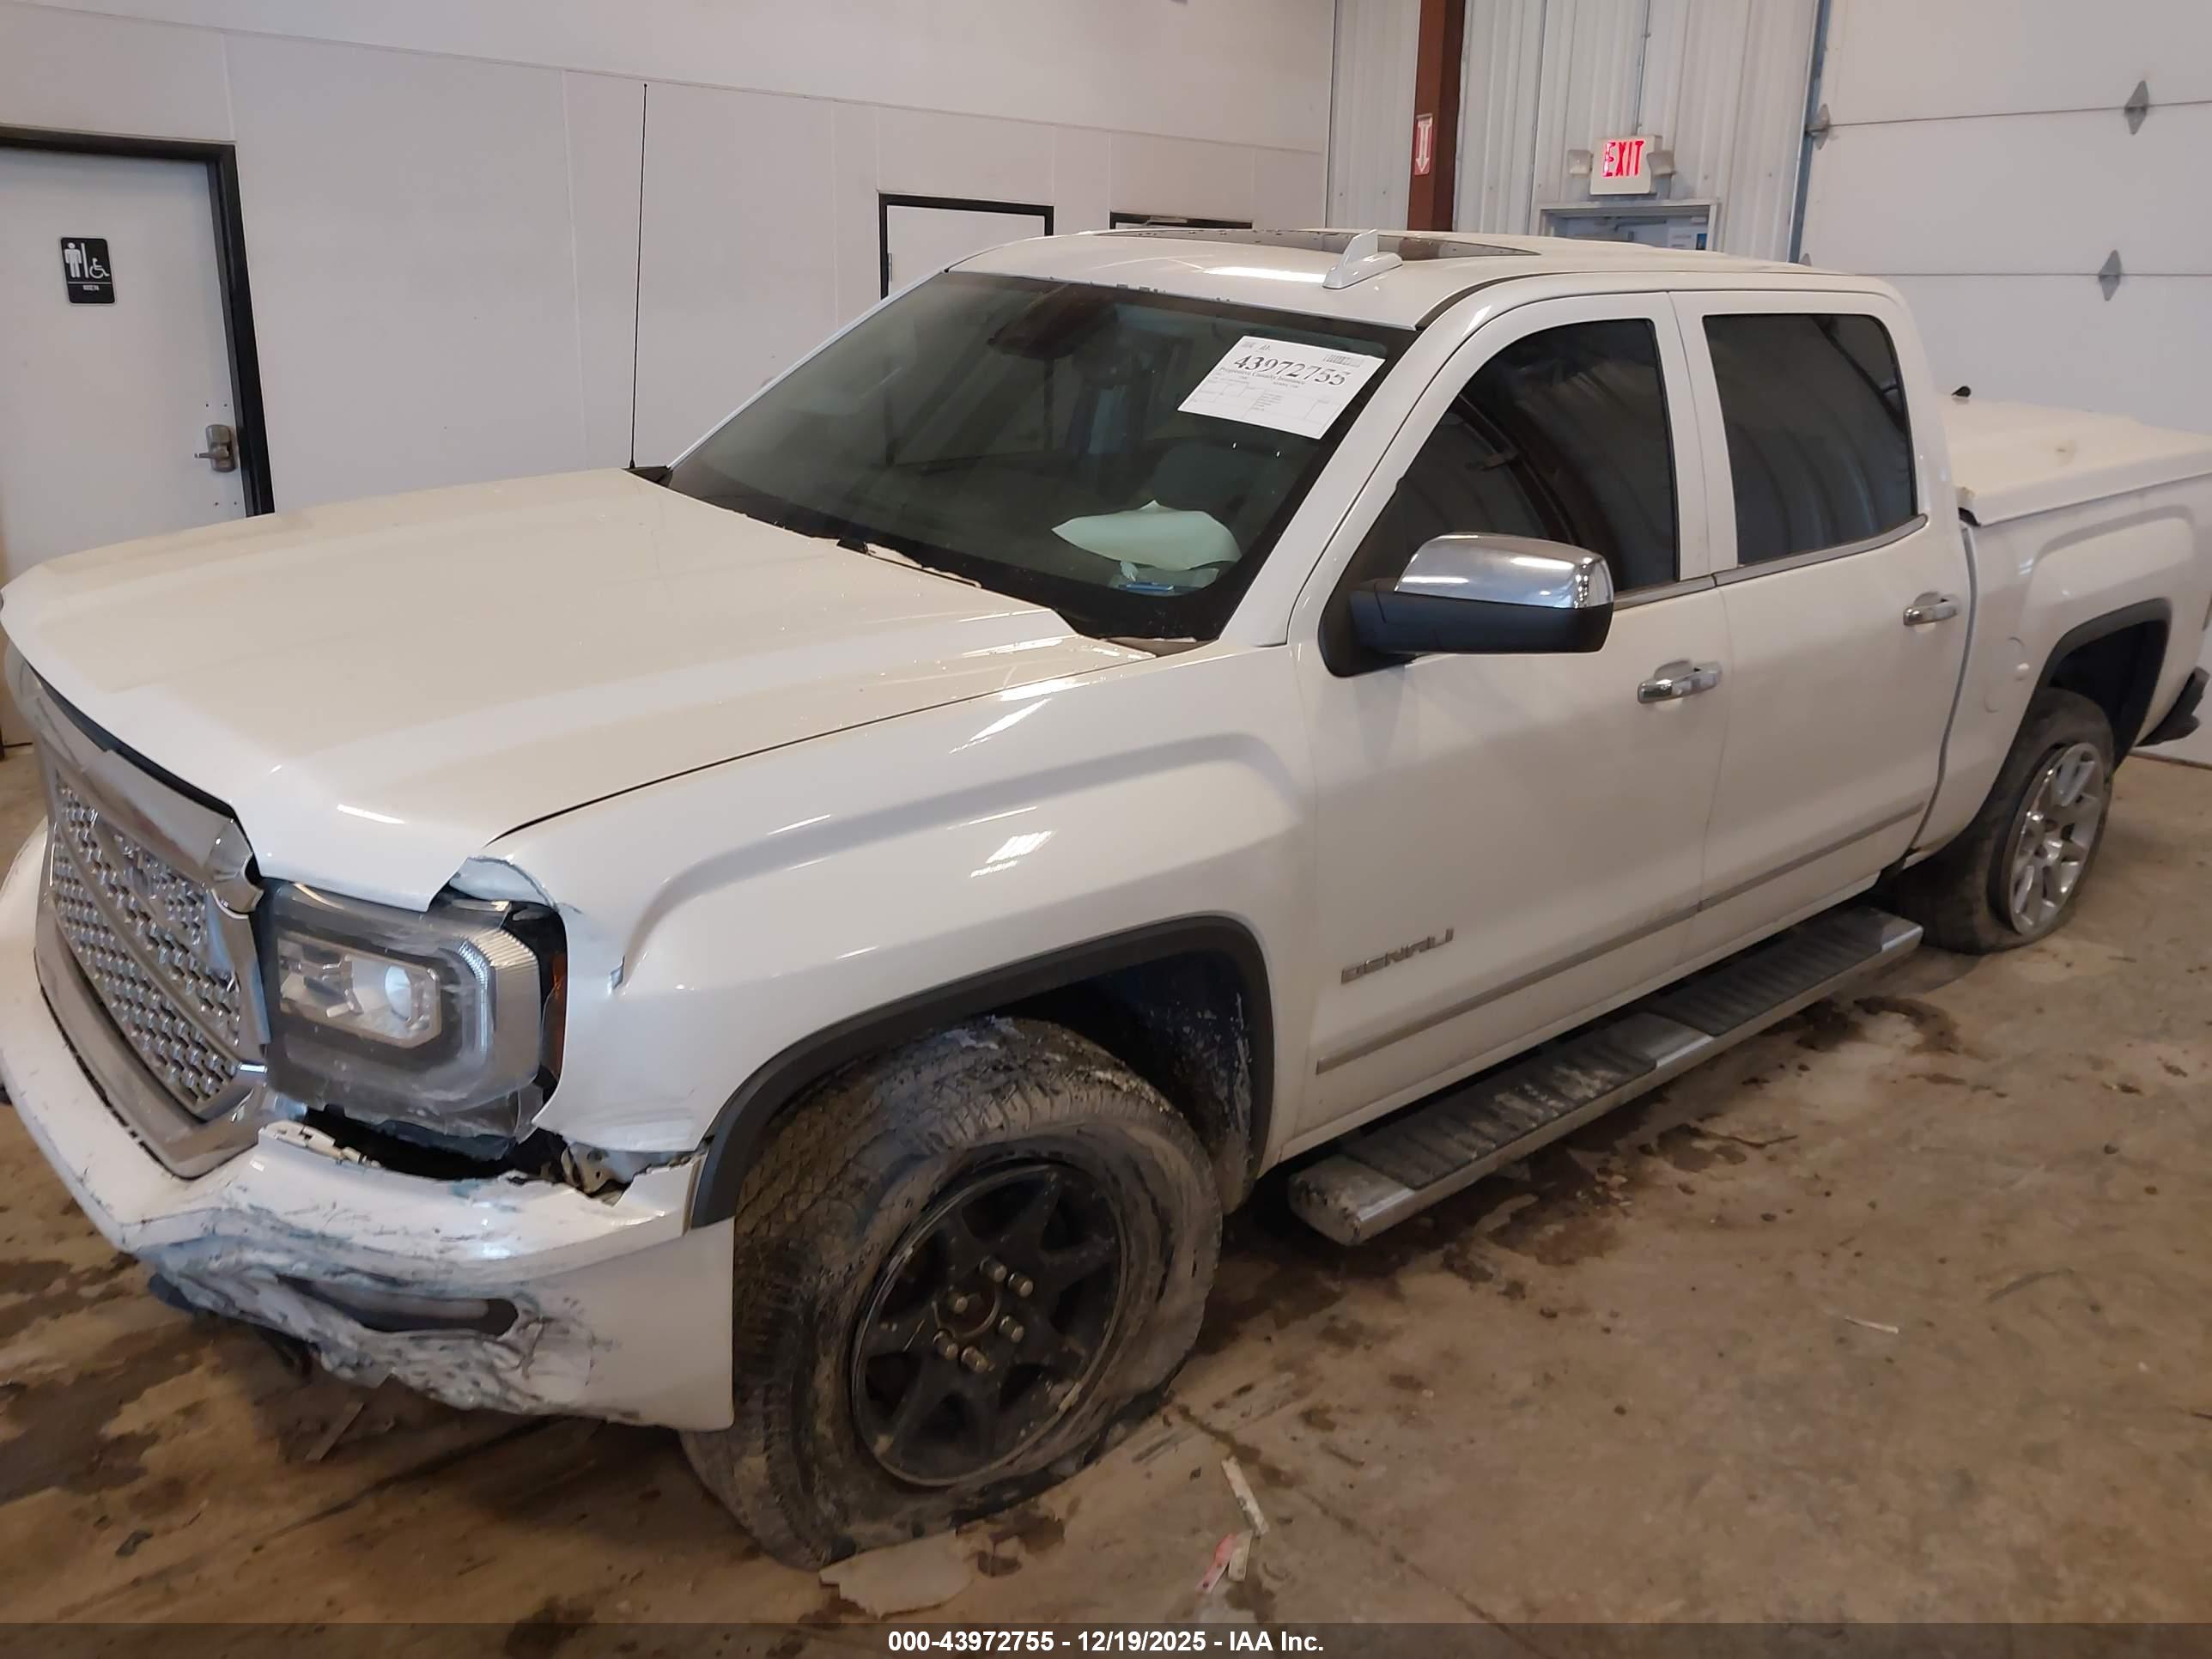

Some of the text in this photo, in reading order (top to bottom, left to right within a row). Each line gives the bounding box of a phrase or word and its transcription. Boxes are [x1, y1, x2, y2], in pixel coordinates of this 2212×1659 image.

[1602, 141, 1644, 178] EXIT
[1233, 355, 1352, 386] 43972755
[1340, 927, 1455, 985] DENALI
